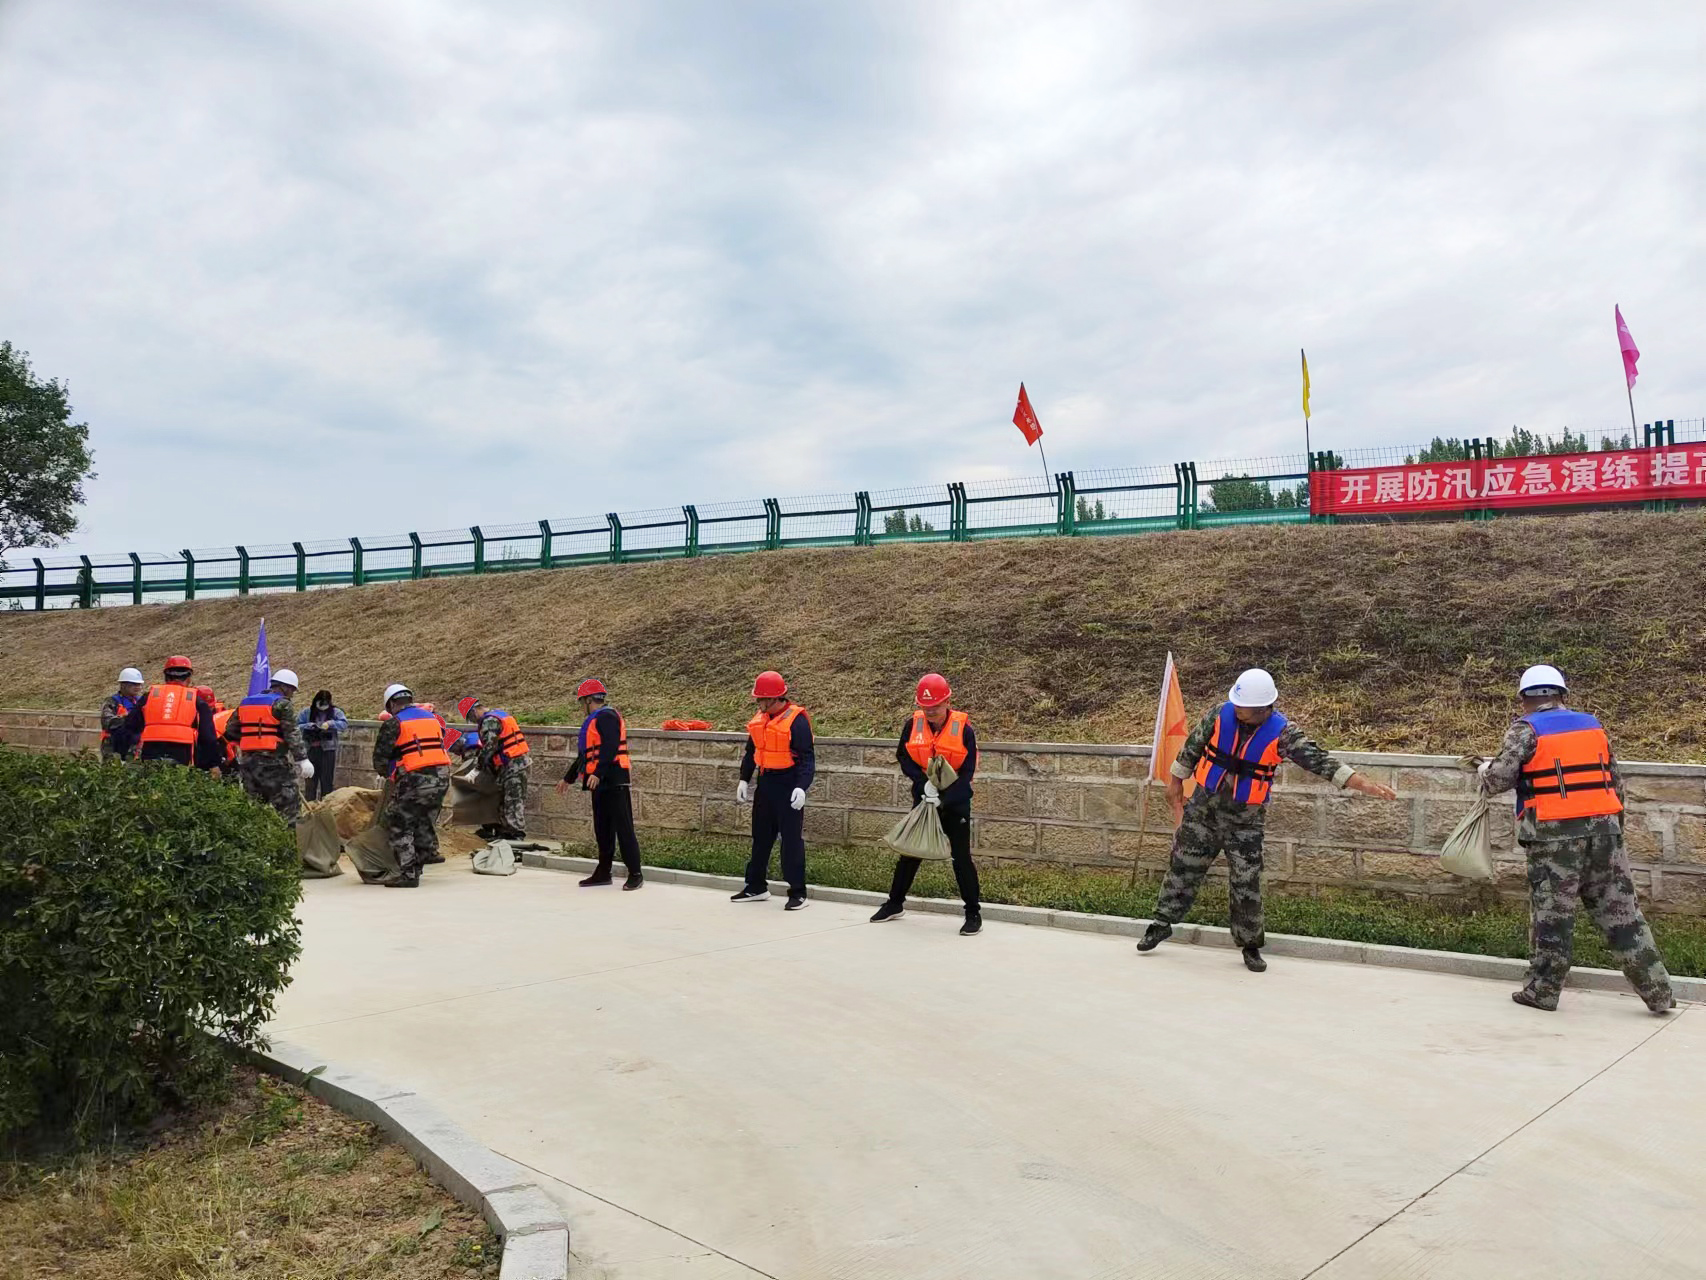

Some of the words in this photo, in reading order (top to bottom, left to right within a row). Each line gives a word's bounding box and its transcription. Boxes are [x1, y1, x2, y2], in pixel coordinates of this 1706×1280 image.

[1340, 456, 1640, 505] 开展防汛应急演练
